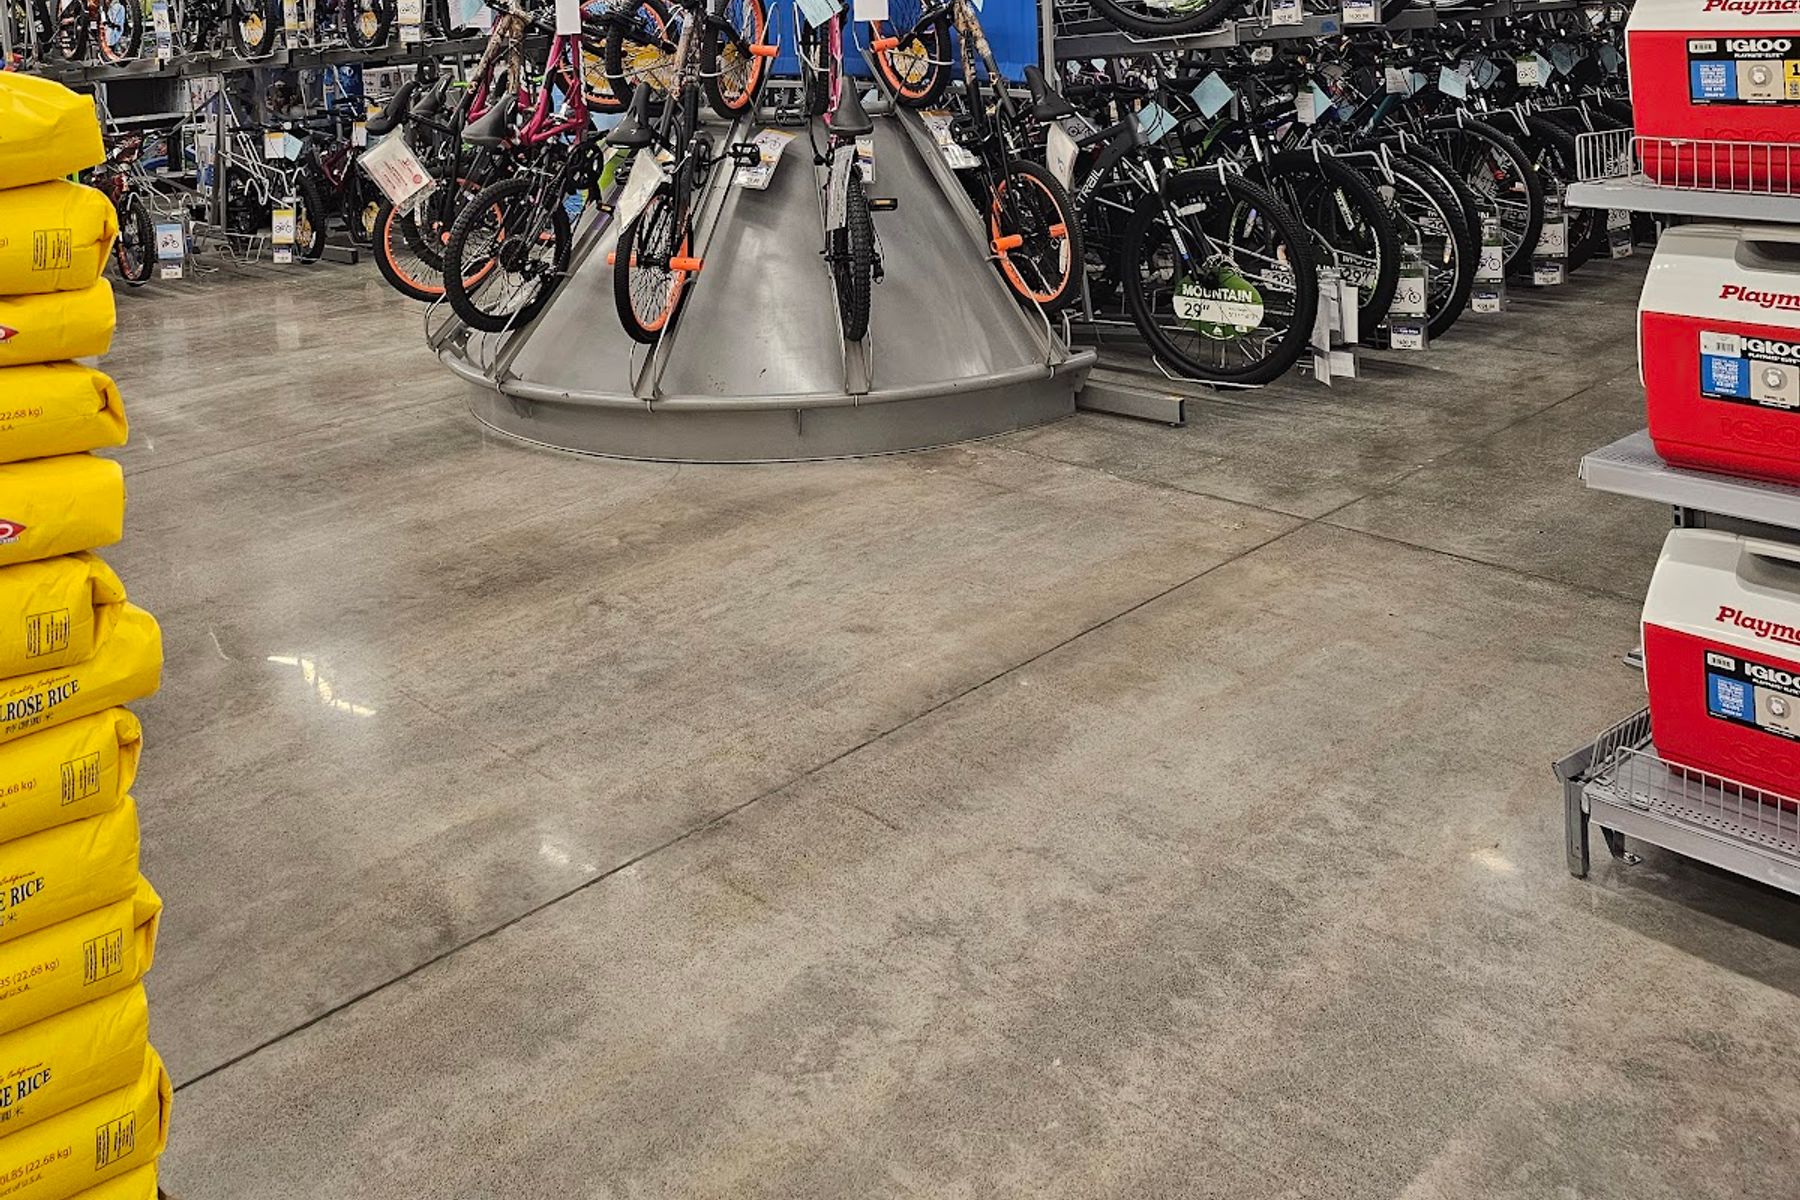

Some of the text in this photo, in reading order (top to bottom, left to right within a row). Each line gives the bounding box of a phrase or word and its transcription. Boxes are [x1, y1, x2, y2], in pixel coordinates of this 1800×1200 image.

[1726, 39, 1792, 52] IGLOO
[1182, 283, 1253, 302] MOUNTAIN
[47, 679, 80, 708] RICE
[10, 877, 45, 907] RICE
[17, 1067, 52, 1100] RICE
